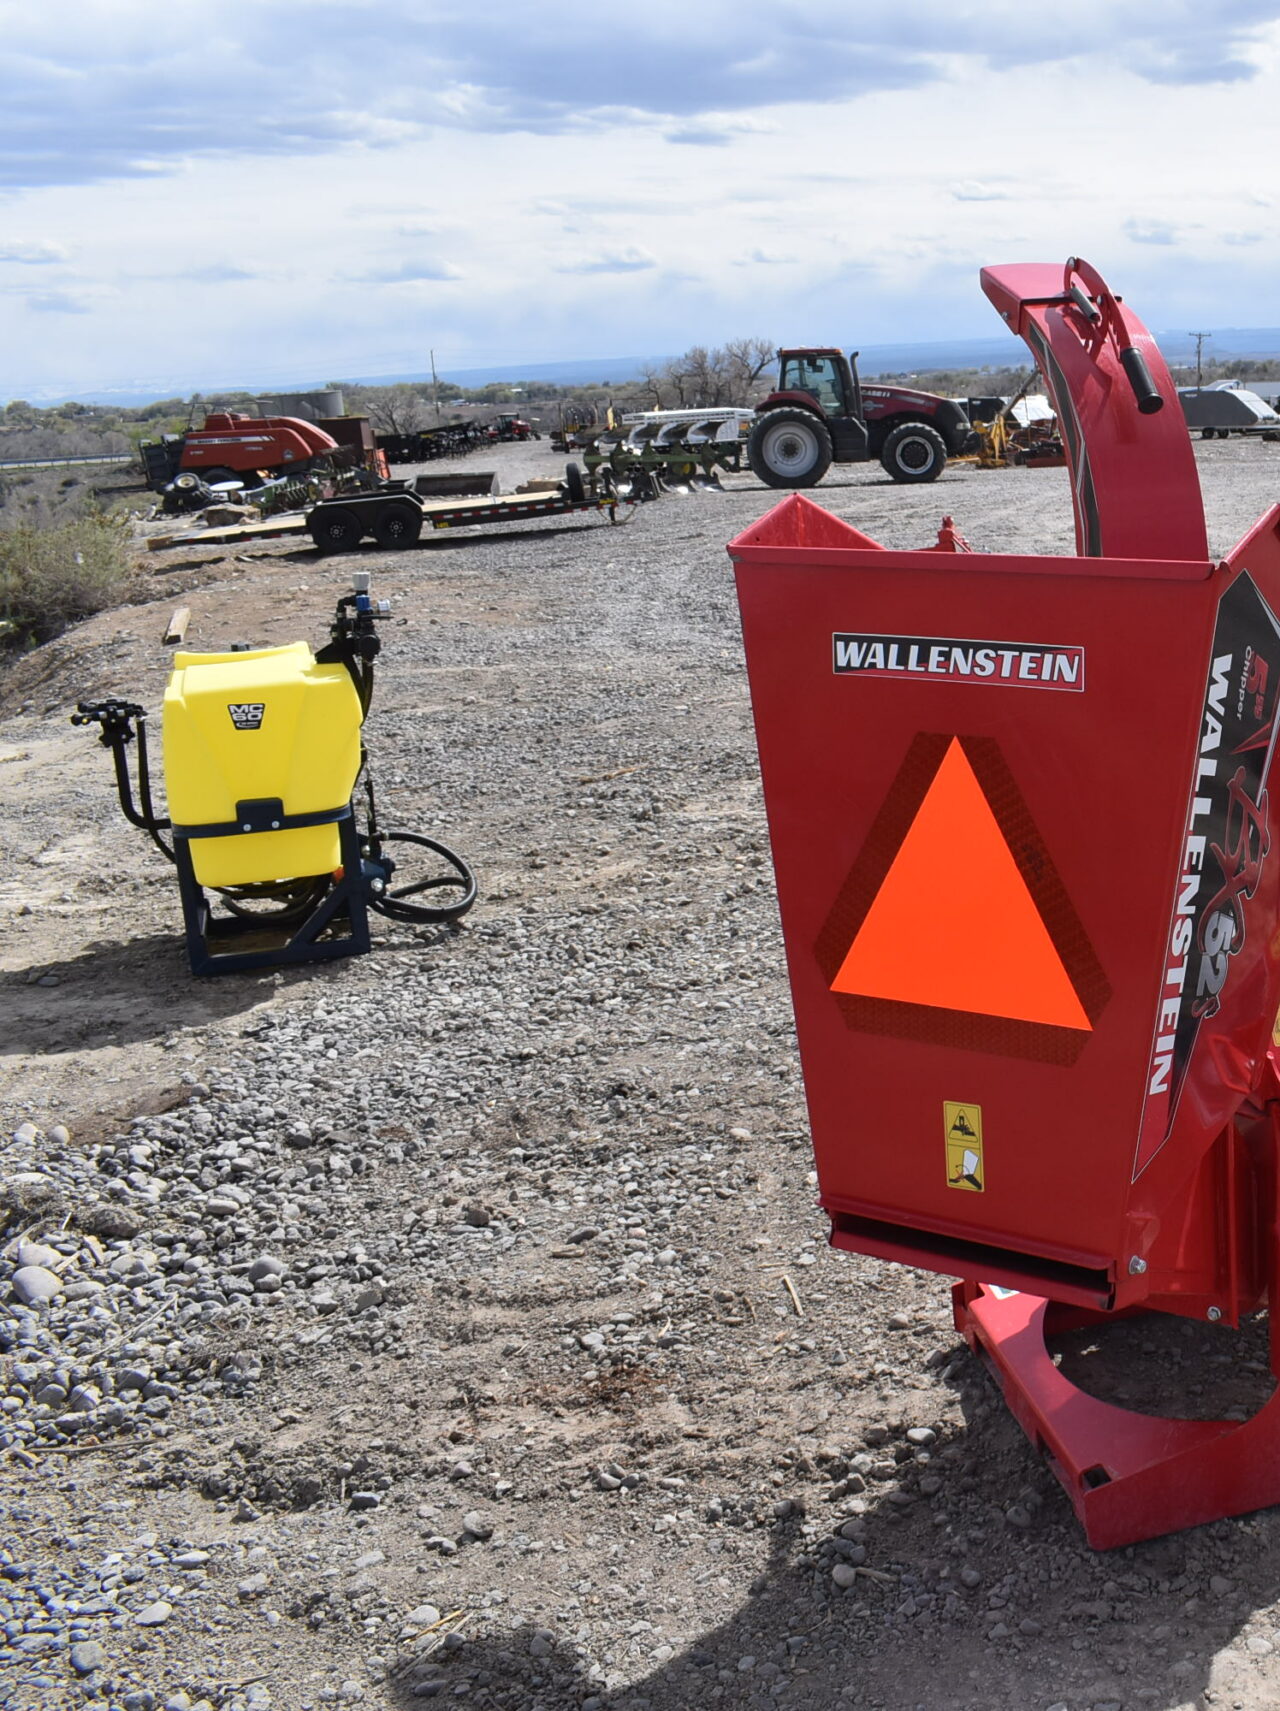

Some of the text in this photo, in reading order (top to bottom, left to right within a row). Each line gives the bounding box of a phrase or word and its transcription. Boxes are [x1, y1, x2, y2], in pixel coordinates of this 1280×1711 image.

[836, 641, 1079, 683] WALLENSTEIN
[1236, 645, 1253, 721] Chipper
[229, 704, 264, 713] MC
[232, 712, 262, 721] 60
[1149, 653, 1232, 1096] WALLENSTEIN
